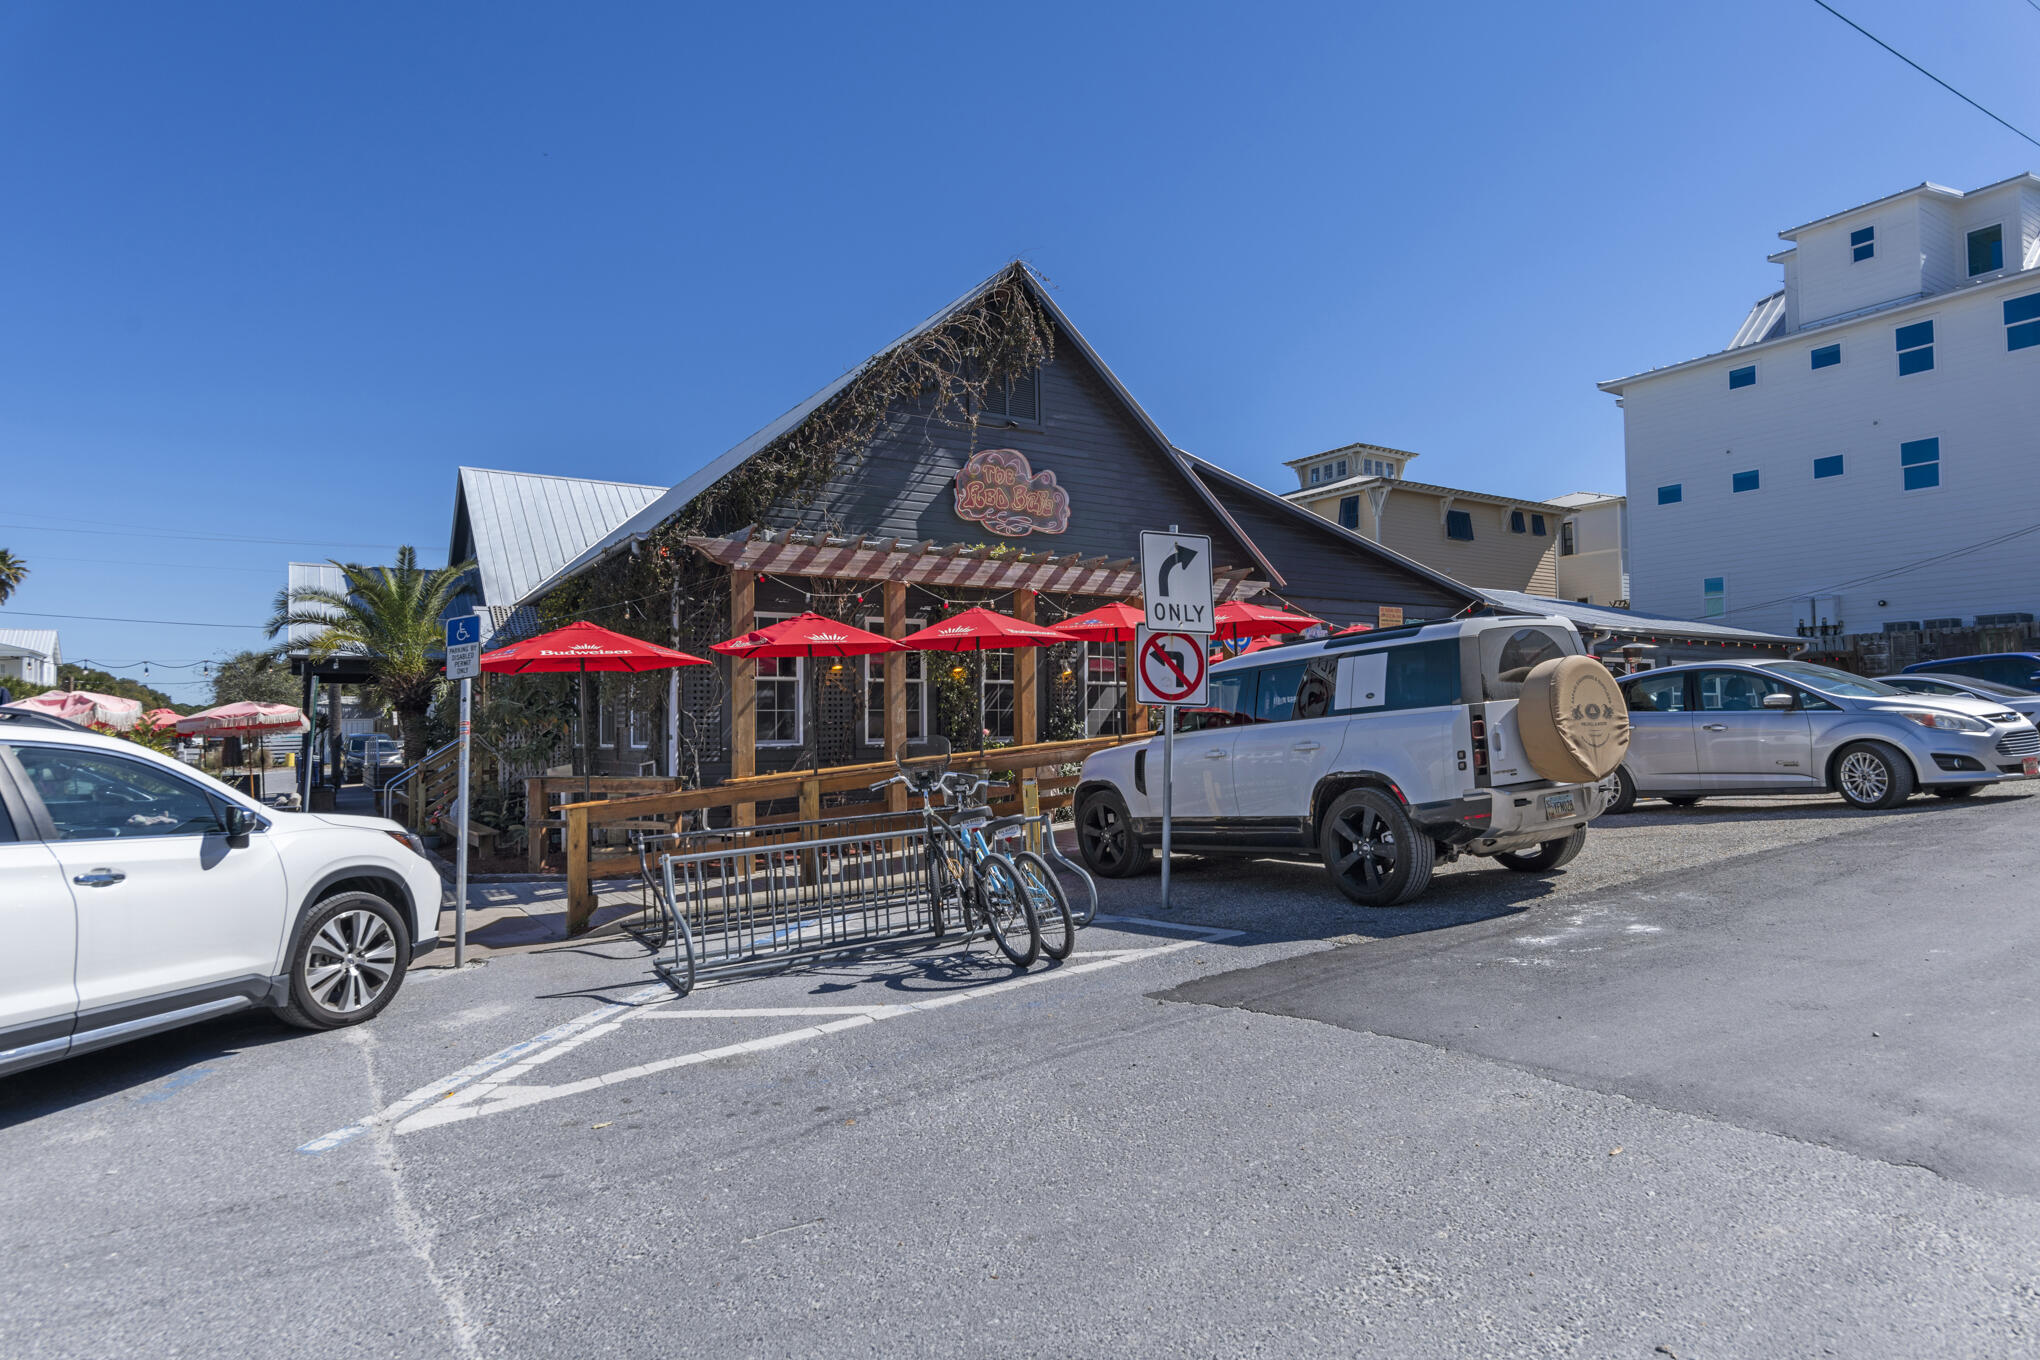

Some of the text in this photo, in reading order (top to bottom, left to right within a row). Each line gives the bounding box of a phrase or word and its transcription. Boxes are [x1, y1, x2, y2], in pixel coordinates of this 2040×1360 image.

[1153, 602, 1206, 623] ONLY
[451, 653, 474, 661] DISABLED
[538, 649, 633, 657] Budweiser
